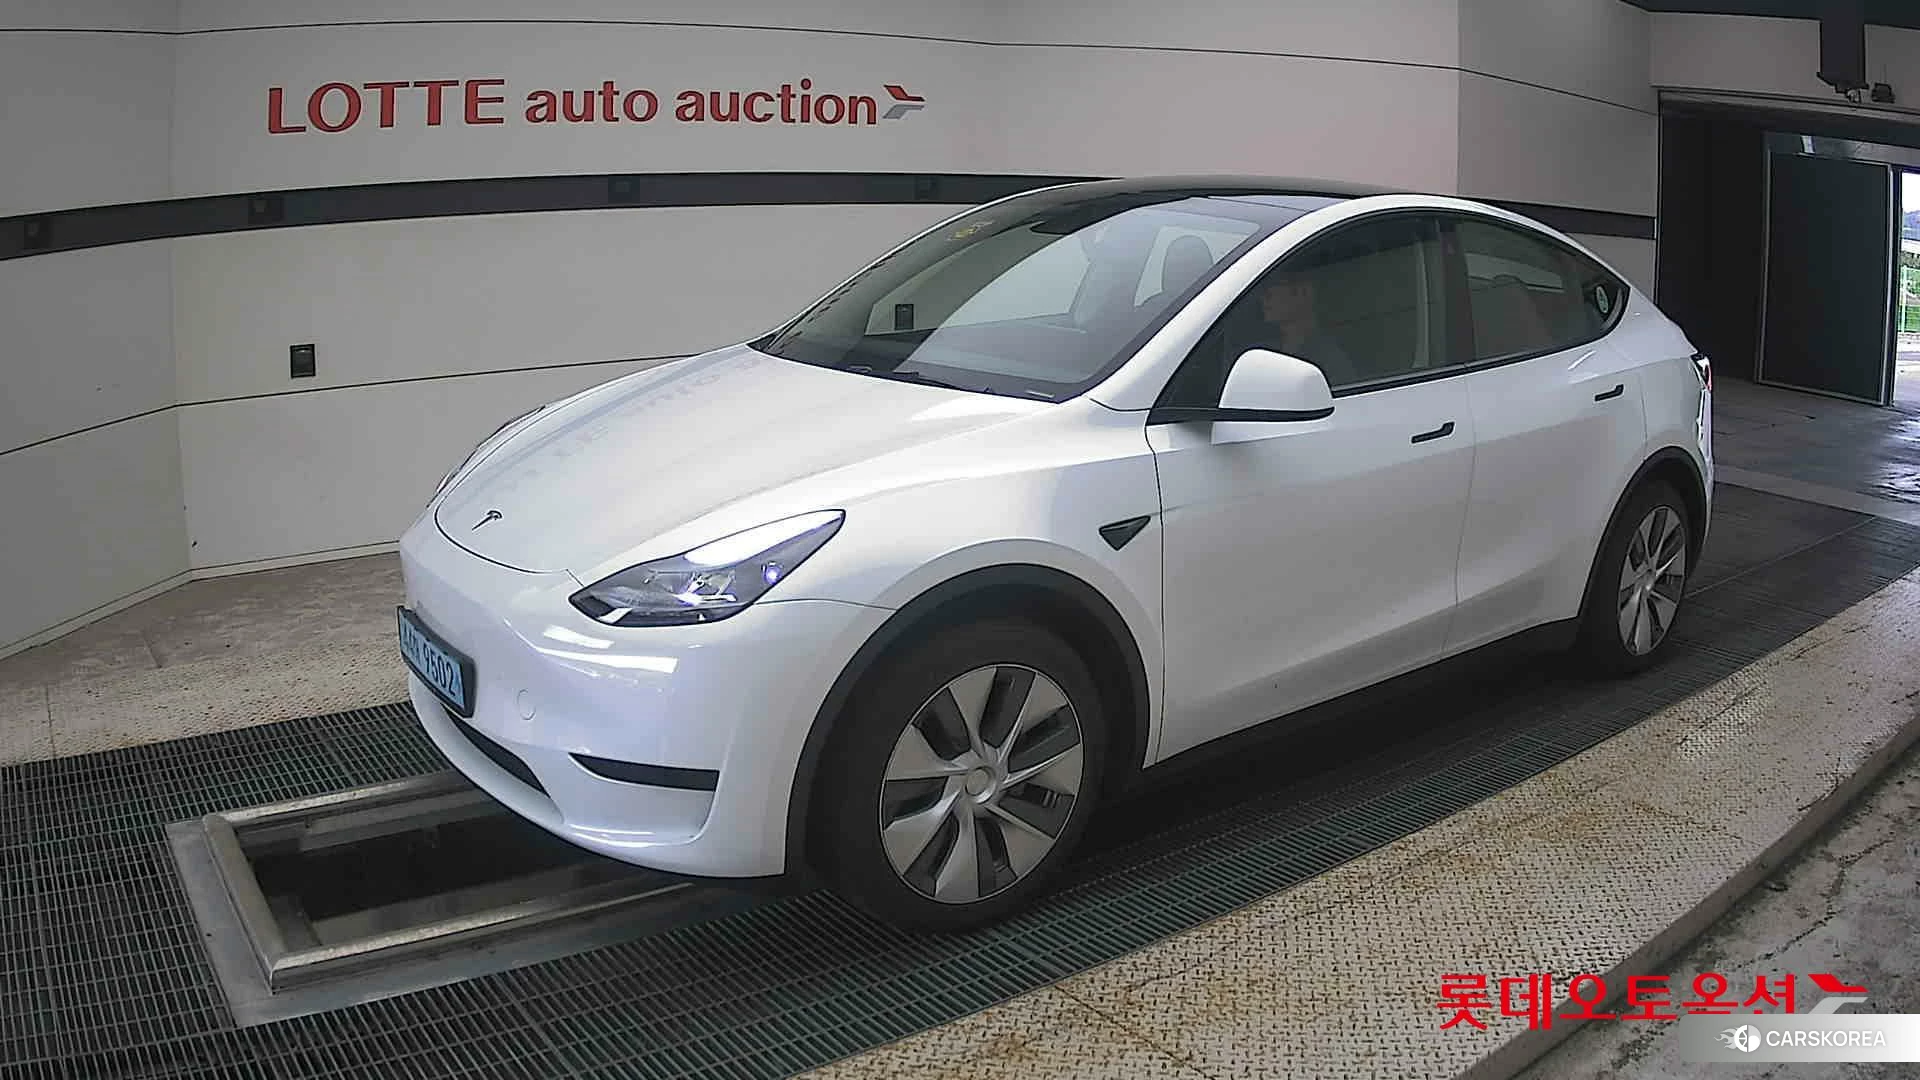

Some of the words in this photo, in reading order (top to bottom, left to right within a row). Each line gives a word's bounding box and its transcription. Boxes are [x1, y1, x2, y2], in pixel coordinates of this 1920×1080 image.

[268, 79, 505, 134] LOTTE
[525, 81, 659, 123] auto
[675, 78, 878, 125] auction
[423, 642, 456, 697] 9502
